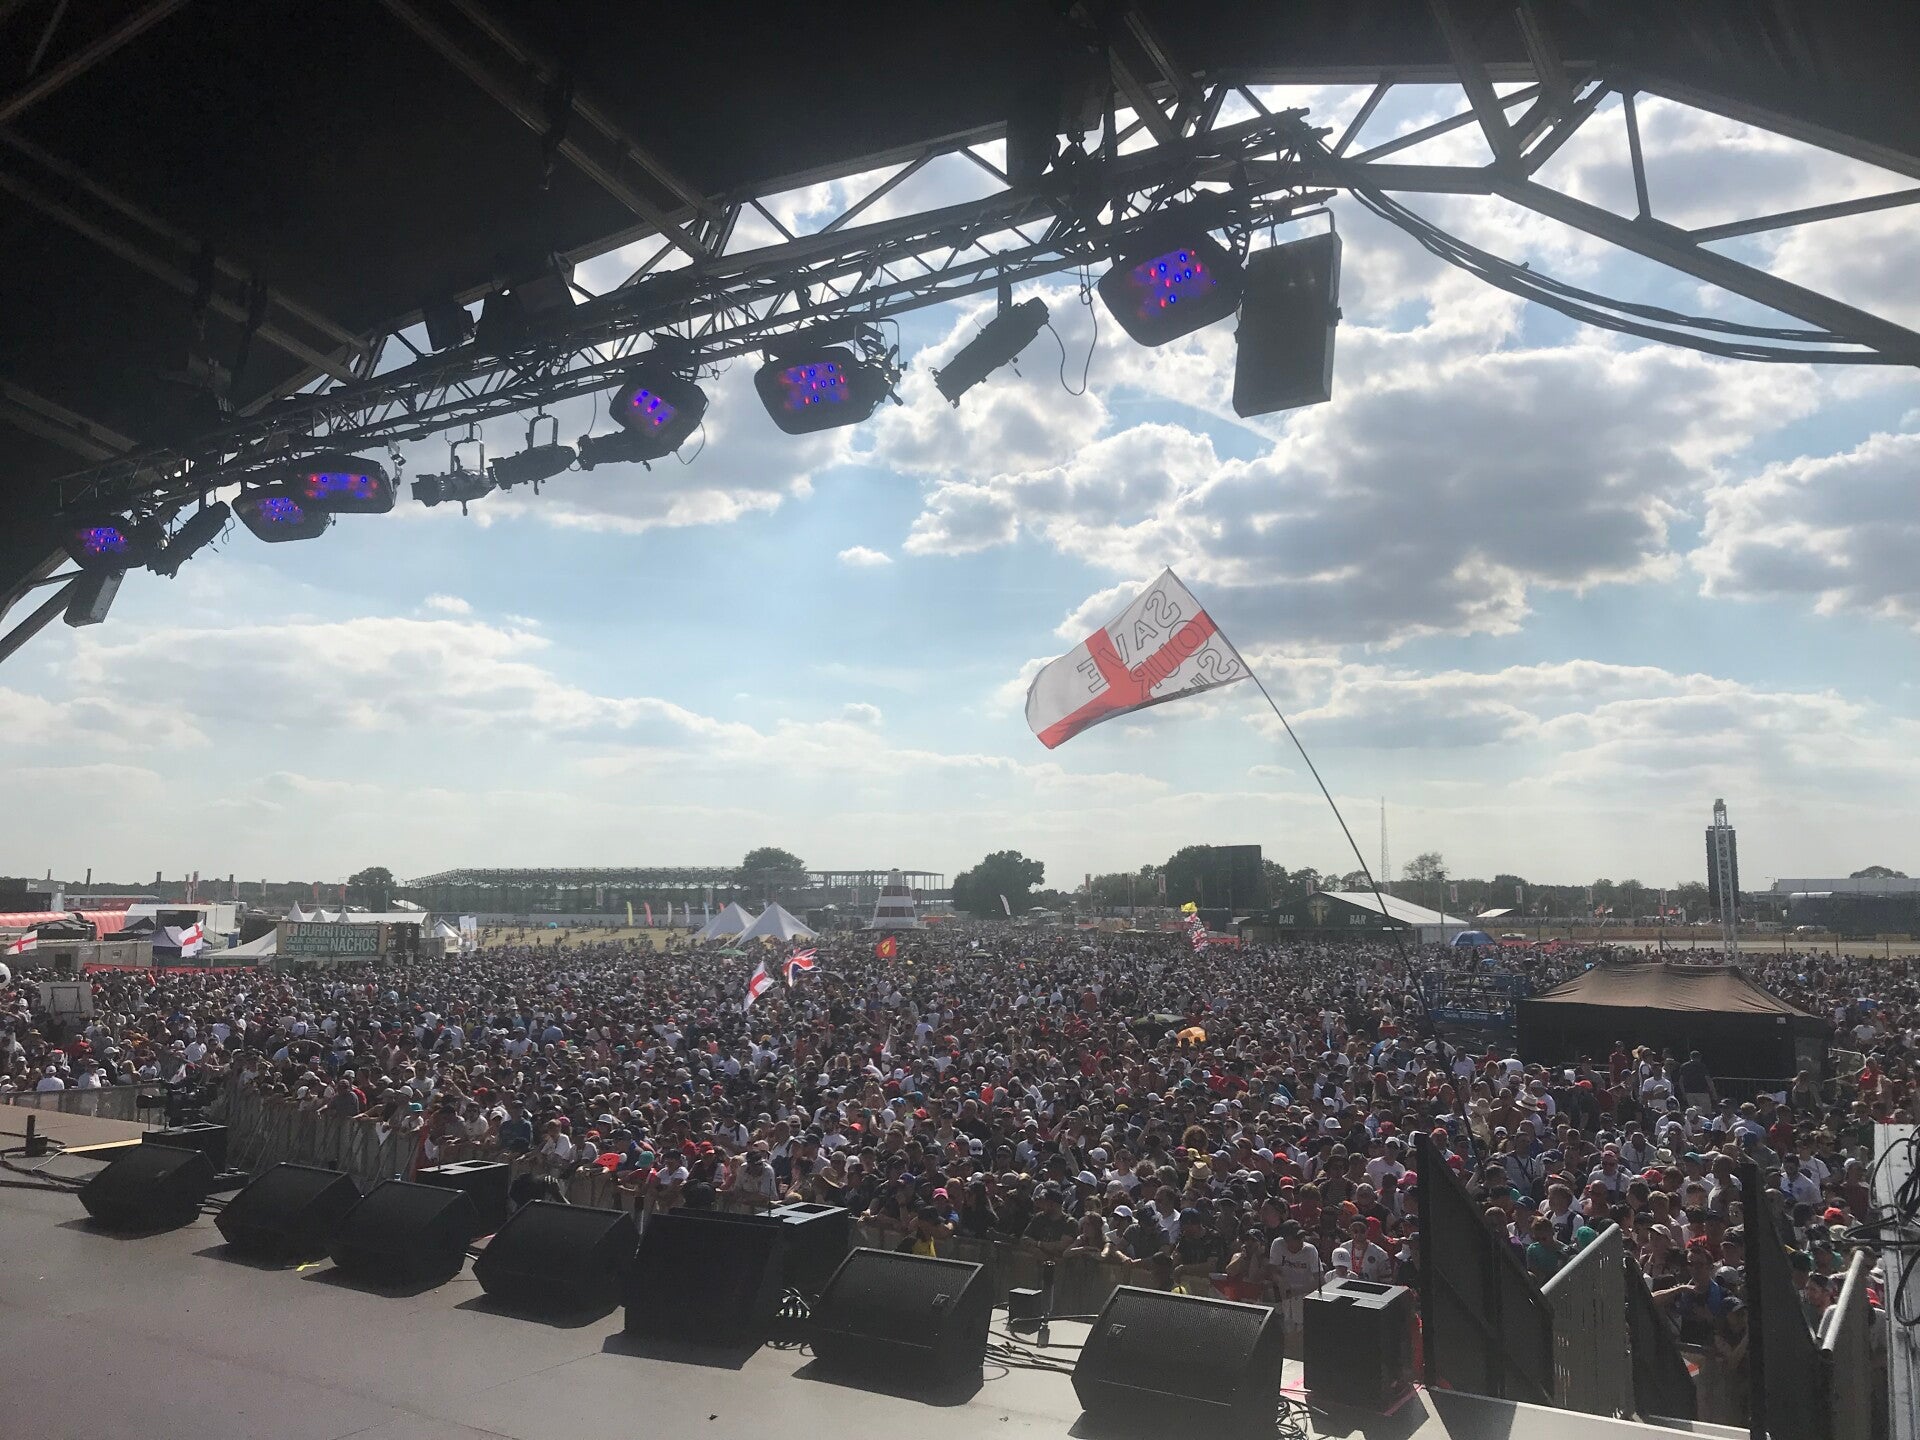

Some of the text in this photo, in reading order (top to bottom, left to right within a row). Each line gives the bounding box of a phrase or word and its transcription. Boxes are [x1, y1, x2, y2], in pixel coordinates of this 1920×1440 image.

[1278, 914, 1295, 925] BAR
[1349, 914, 1367, 925] BAR
[300, 924, 354, 937] BURRITOS
[330, 937, 377, 951] NACHOS
